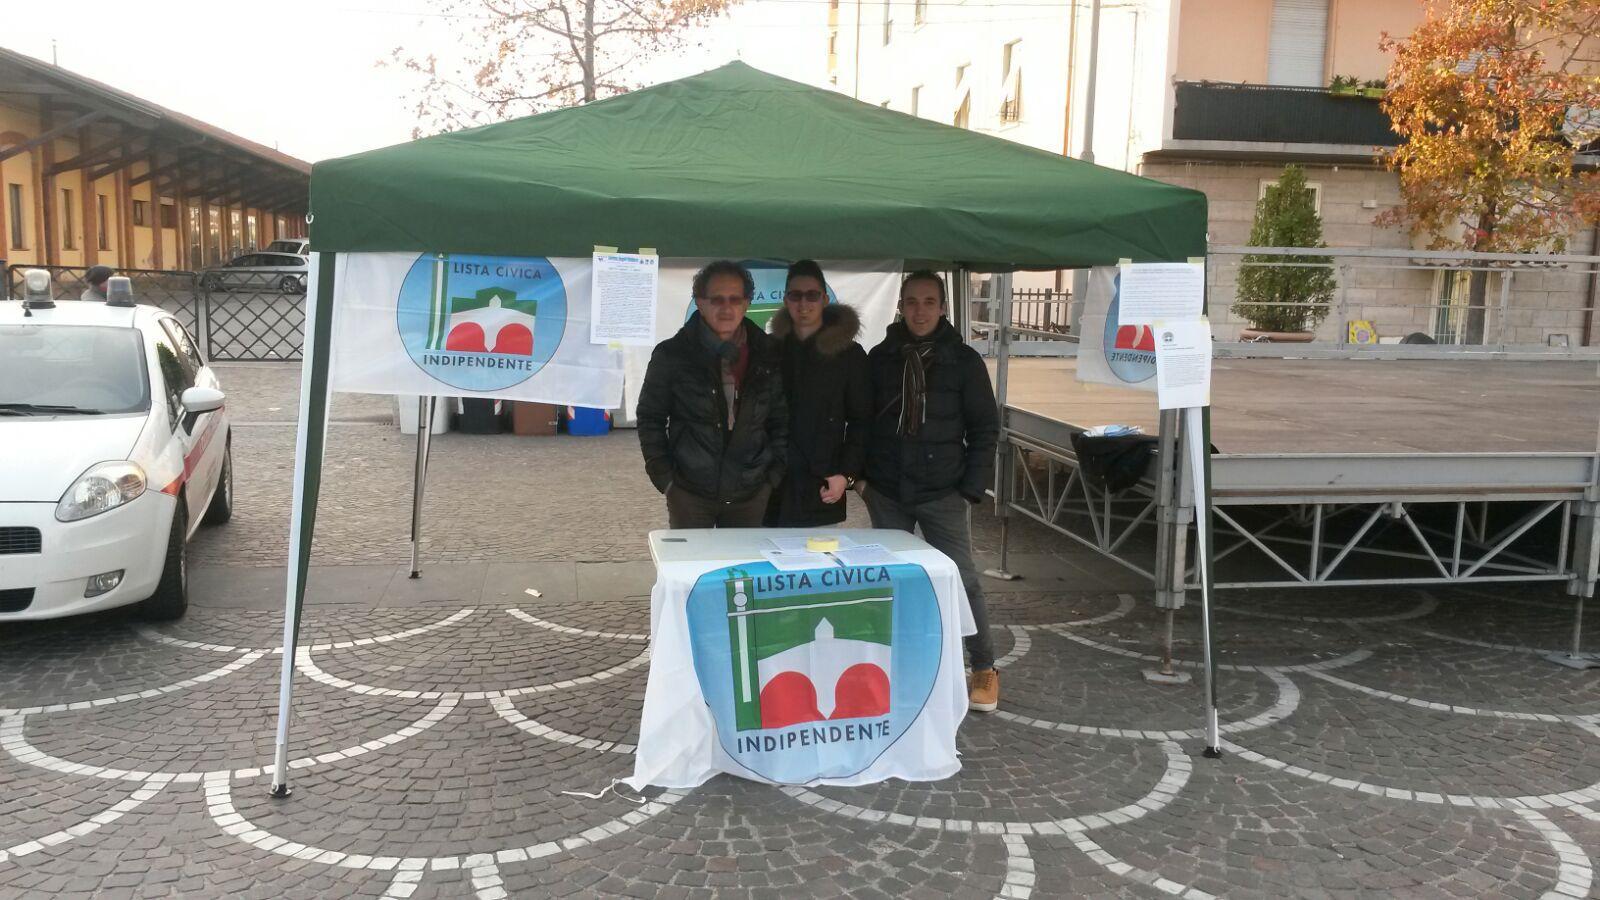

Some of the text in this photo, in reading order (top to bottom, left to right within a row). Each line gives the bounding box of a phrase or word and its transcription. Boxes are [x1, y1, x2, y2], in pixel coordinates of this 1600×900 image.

[454, 263, 541, 279] LISTA CIVICA
[424, 355, 532, 370] INDIPENDENTE
[757, 566, 891, 592] LISTA CIVICA
[737, 720, 890, 753] INDIPENDENTE
